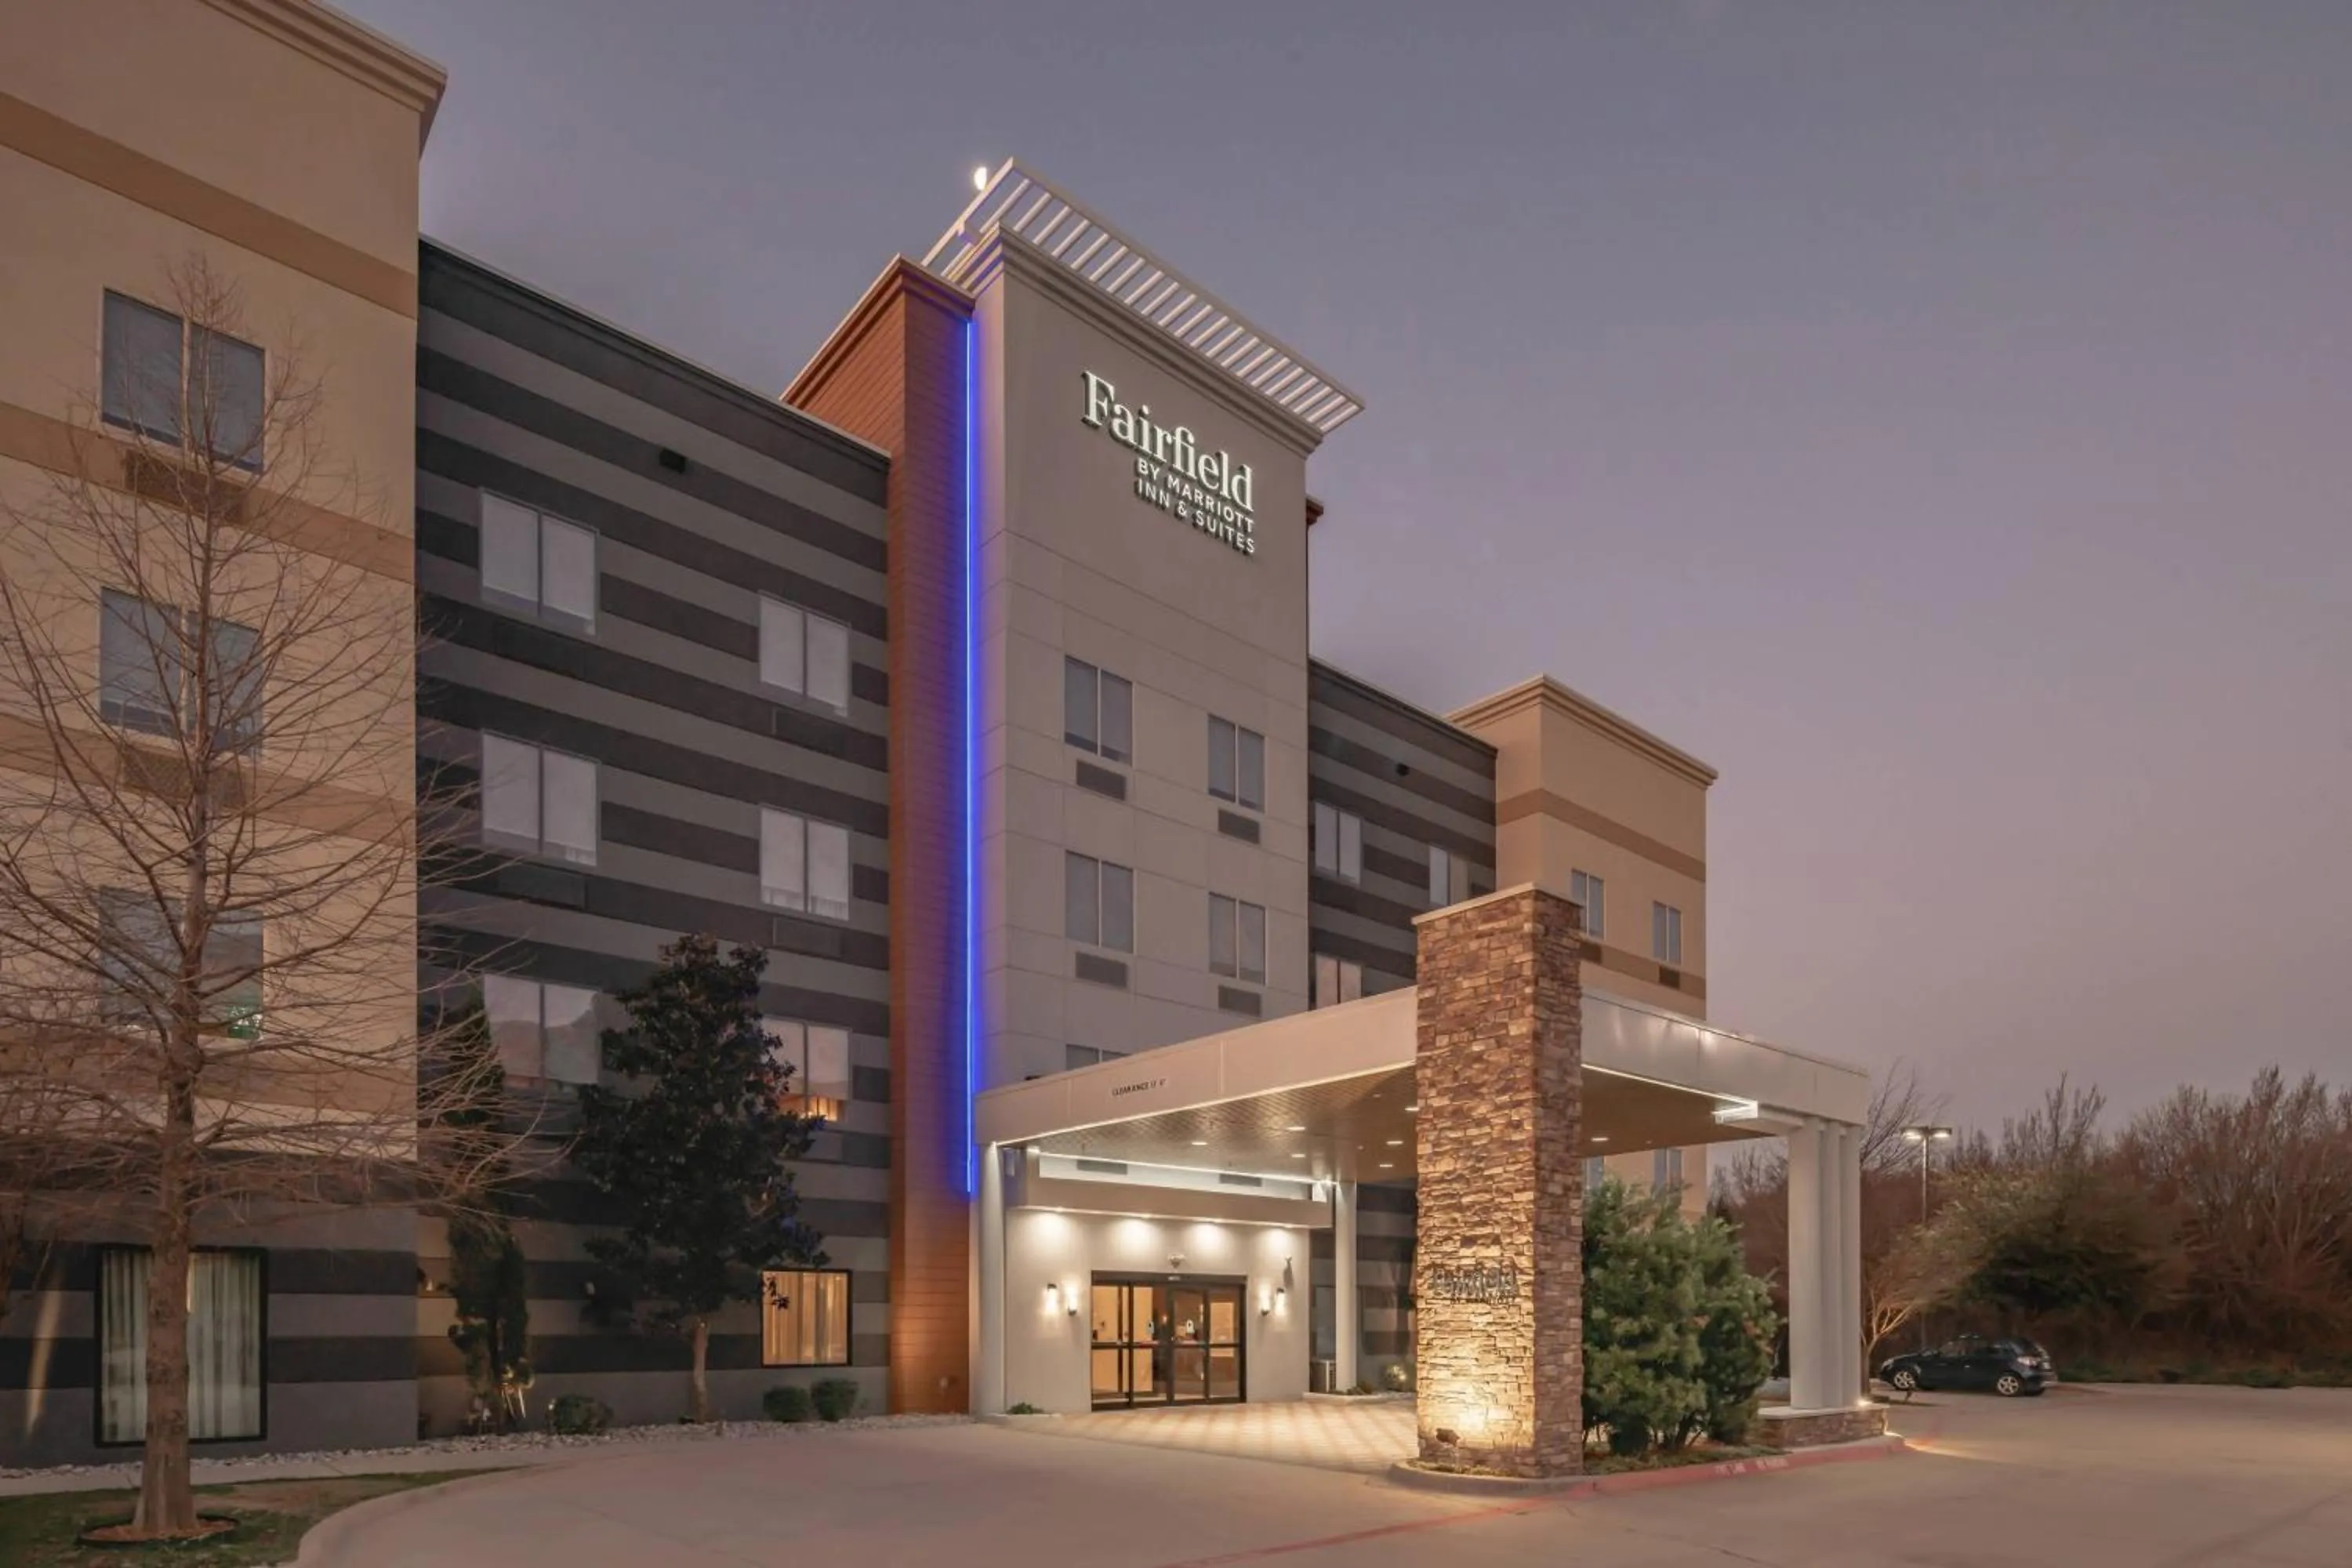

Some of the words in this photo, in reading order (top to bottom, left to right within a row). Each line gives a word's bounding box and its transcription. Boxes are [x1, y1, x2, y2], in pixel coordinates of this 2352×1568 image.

[1081, 370, 1254, 513] Fairfield
[1137, 457, 1160, 481] BY
[1167, 474, 1254, 533] MARRIOTT
[1137, 478, 1171, 509] INN
[1177, 500, 1189, 517] &
[1195, 510, 1255, 554] SUITES
